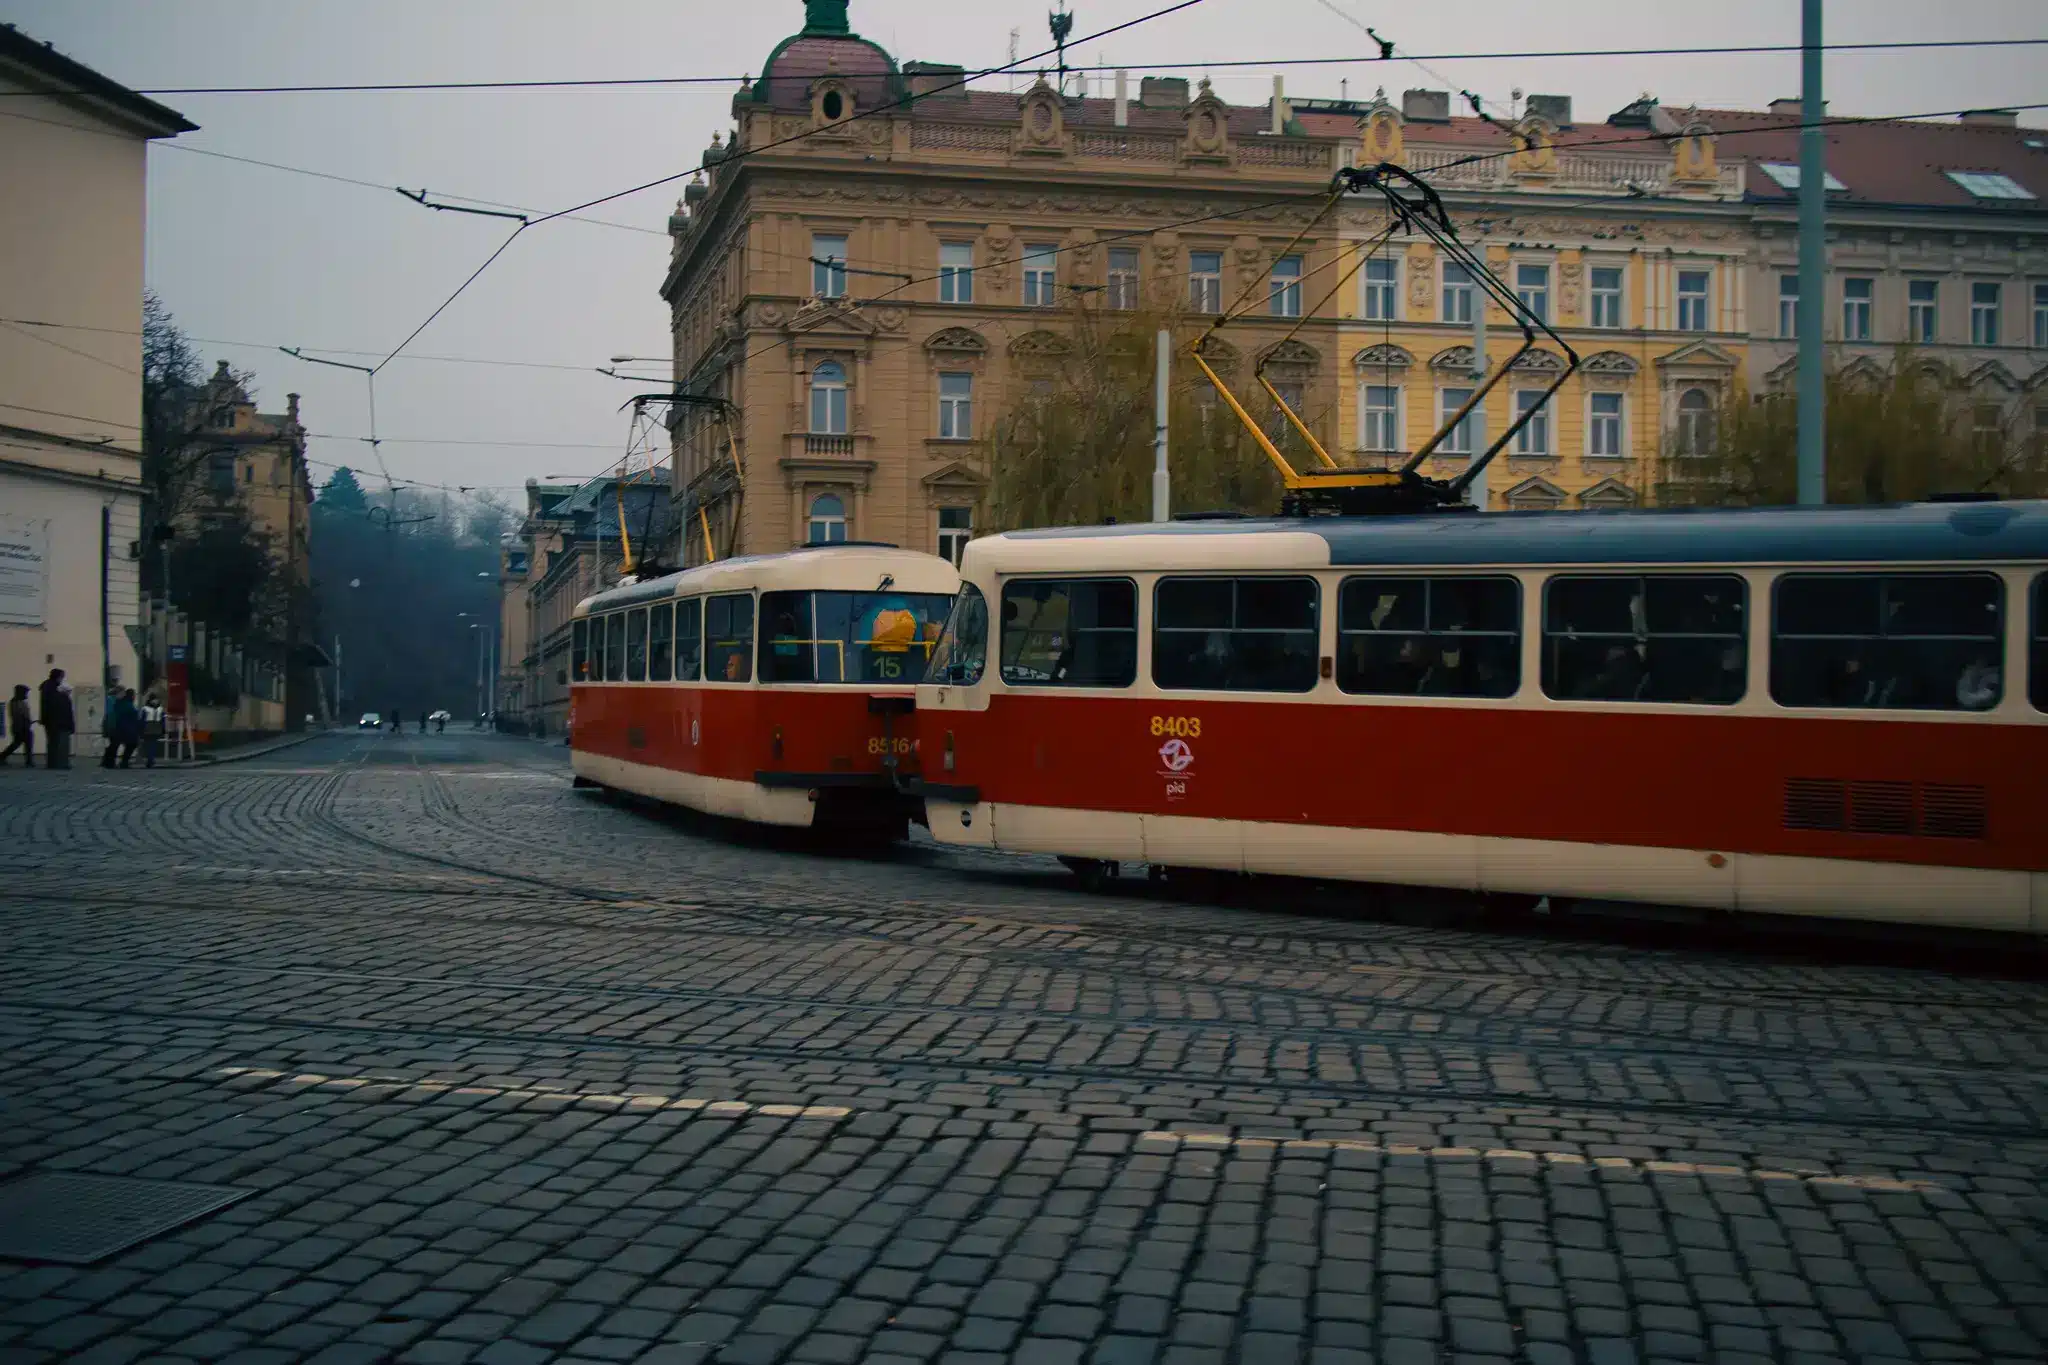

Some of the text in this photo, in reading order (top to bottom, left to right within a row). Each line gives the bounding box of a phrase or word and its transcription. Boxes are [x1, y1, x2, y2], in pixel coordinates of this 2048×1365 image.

[873, 656, 901, 678] 15
[1151, 716, 1202, 738] 8403
[868, 737, 909, 754] 8516
